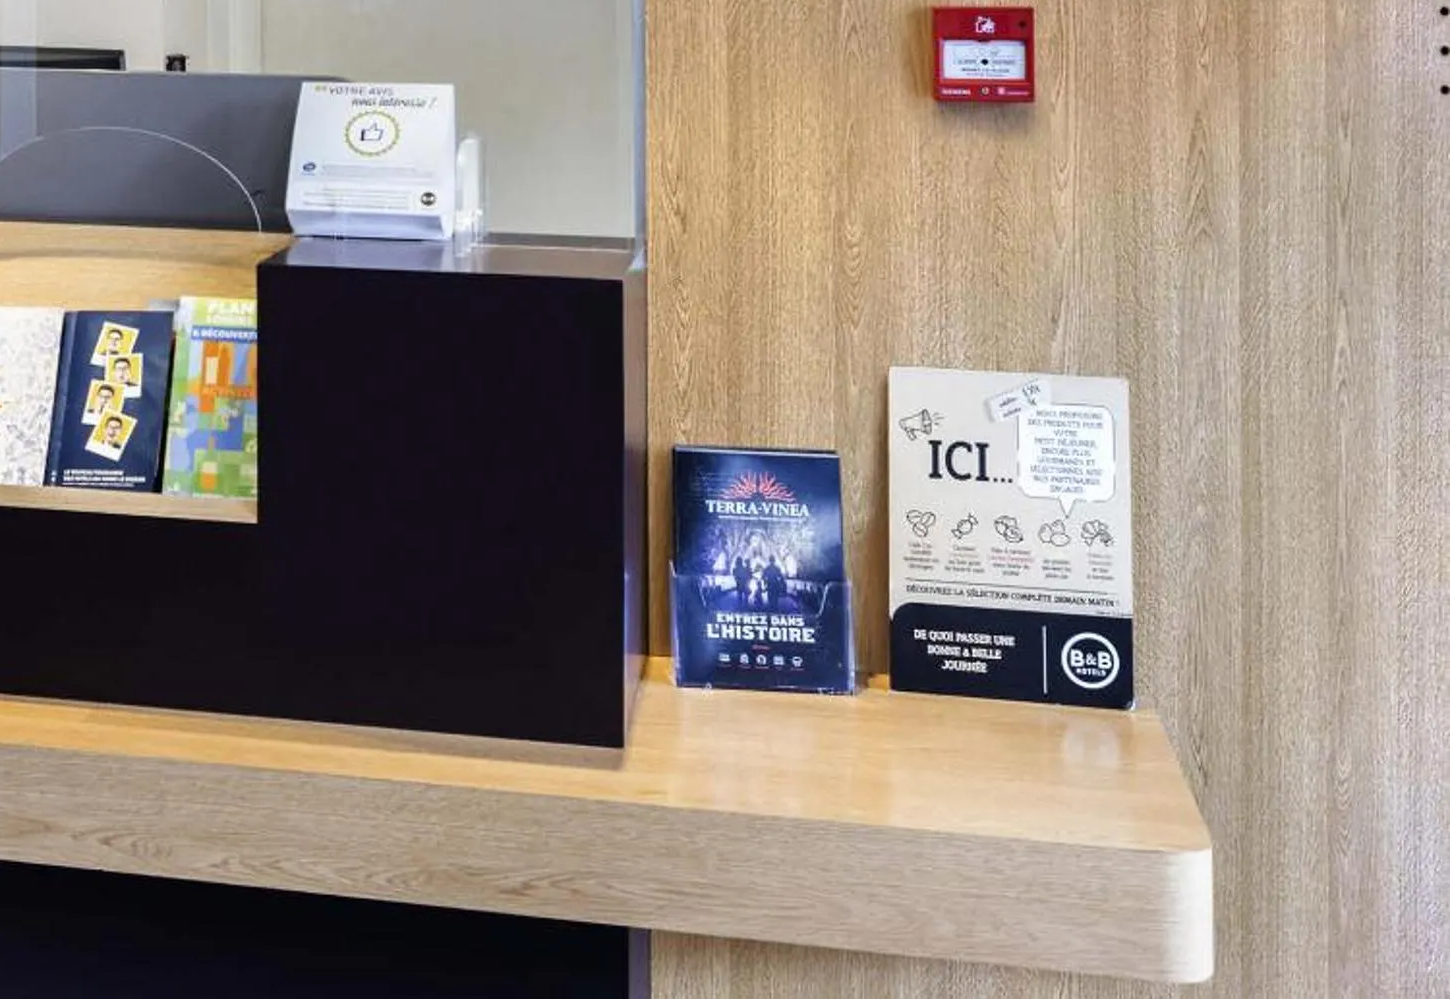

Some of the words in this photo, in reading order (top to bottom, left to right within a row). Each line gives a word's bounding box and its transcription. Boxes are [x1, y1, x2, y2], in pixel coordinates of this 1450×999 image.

[330, 86, 365, 96] VOTRE
[368, 87, 394, 97] AVIS
[927, 439, 1014, 484] ICI...
[906, 584, 952, 595] DÉCOUVREZ
[955, 588, 965, 596] LA
[966, 587, 1009, 600] SÉLECTION
[1054, 595, 1086, 605] DEMAIN
[1088, 597, 1114, 607] MATIN
[716, 612, 768, 625] ENTREZ
[771, 615, 805, 627] DANS
[706, 623, 816, 643] L'HISTOIRE
[914, 629, 927, 640] DE
[928, 630, 954, 642] QUOI
[955, 631, 992, 645] PASSER
[993, 635, 1015, 647] UNE
[927, 645, 961, 657] BONNE
[962, 648, 970, 657] &
[972, 648, 1002, 660] BELLE
[1070, 649, 1112, 669] B&B
[941, 660, 988, 673] JOURNÉE
[1076, 668, 1107, 677] HOTELS
